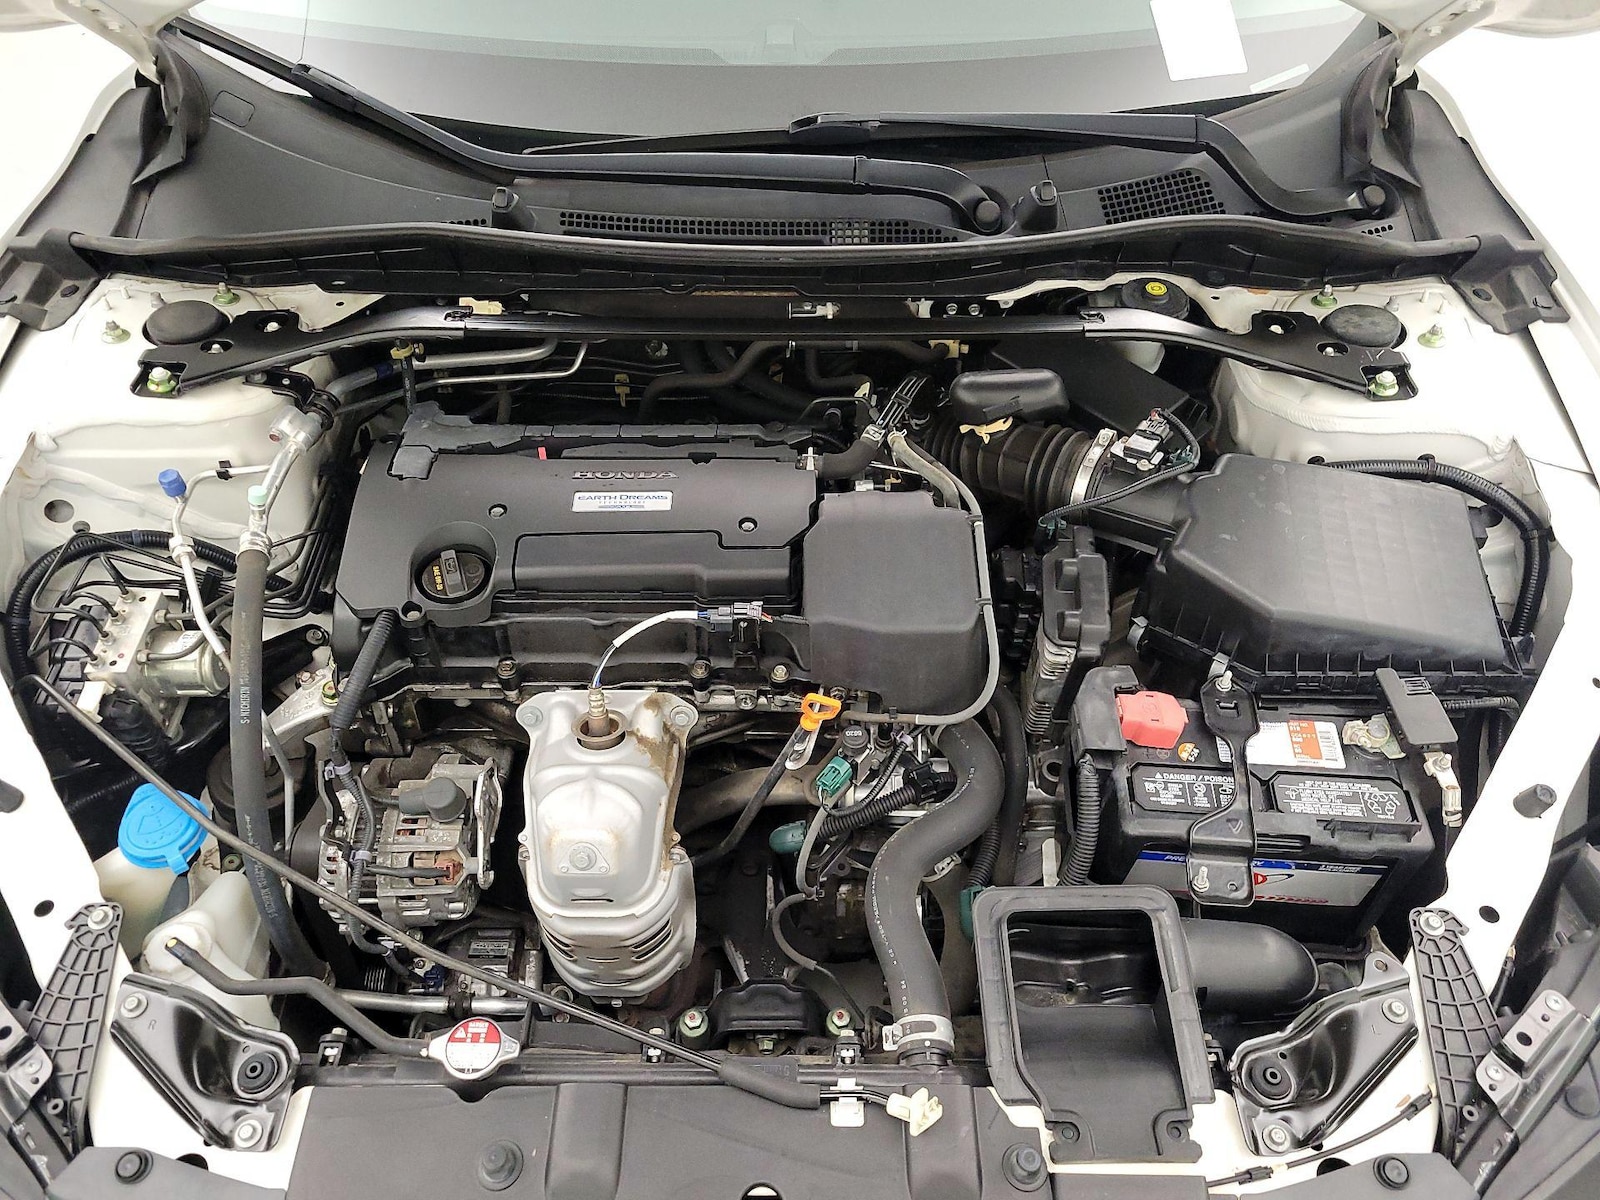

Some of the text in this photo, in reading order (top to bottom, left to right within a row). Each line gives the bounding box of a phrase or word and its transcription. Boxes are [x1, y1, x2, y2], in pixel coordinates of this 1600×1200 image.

[572, 471, 679, 480] HONDA
[1162, 772, 1197, 782] DANGER
[1203, 775, 1234, 783] POISON
